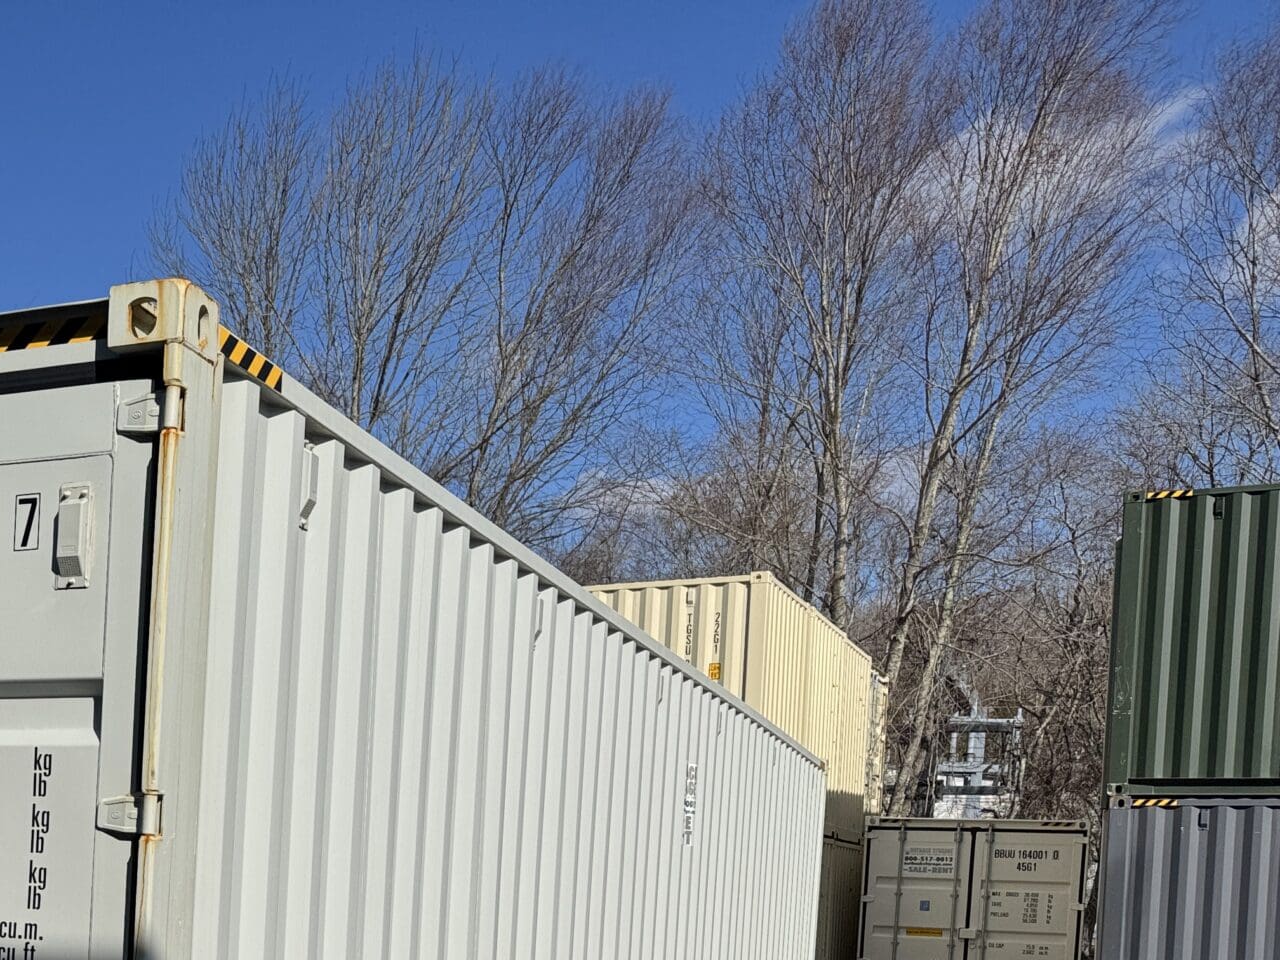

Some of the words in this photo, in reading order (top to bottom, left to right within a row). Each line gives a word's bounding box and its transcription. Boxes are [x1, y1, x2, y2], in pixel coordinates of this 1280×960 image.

[17, 497, 39, 548] 7
[713, 612, 721, 655] 22G1
[33, 746, 52, 777] kg
[32, 772, 47, 797] lb
[31, 803, 50, 834] kg
[30, 829, 45, 854] lb
[28, 860, 47, 891] kg
[27, 885, 42, 910] lb
